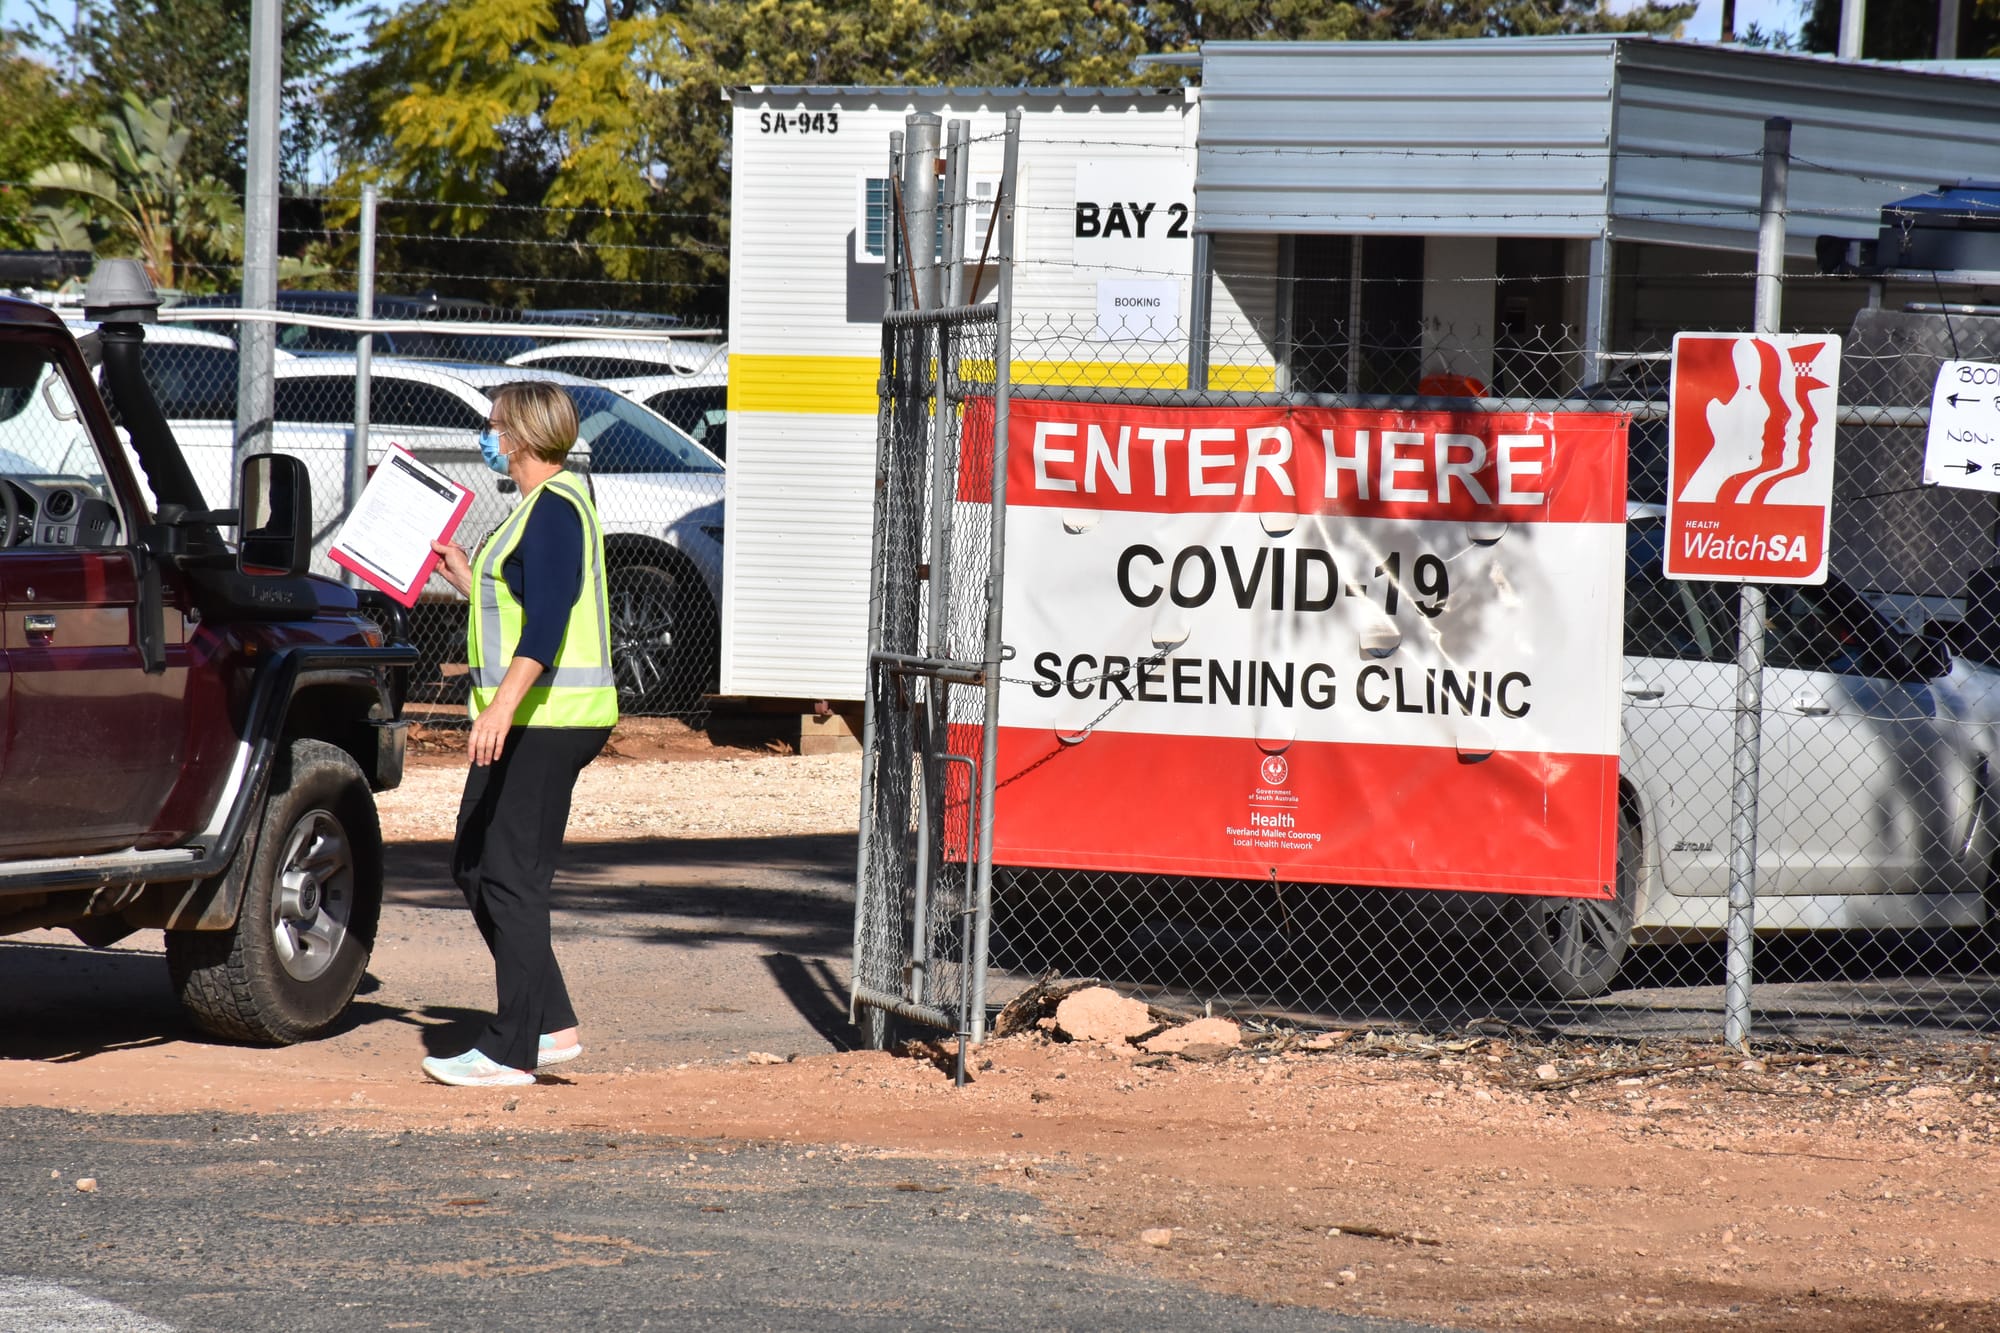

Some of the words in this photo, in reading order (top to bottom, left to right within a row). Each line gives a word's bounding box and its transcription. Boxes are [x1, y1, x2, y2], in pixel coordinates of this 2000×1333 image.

[760, 112, 838, 134] SA-943
[1075, 202, 1156, 238] BAY
[1166, 202, 1188, 238] 2
[1114, 297, 1161, 307] BOOKING
[1956, 366, 2000, 386] BOO
[1033, 421, 1296, 497] ENTER
[1322, 429, 1545, 505] HERE
[1685, 520, 1720, 529] HEALTH
[1684, 531, 1807, 562] WatchSA
[1117, 544, 1449, 618] COVID-19
[1031, 652, 1337, 710] SCREENING
[1356, 665, 1531, 719] CLINIC
[1250, 812, 1295, 828] Health
[1226, 827, 1260, 837] Riverland
[1261, 829, 1286, 838] Mallee
[1288, 831, 1321, 842] Coorong
[1233, 838, 1252, 847] Local
[1254, 840, 1278, 848] Health
[1280, 841, 1313, 850] Network
